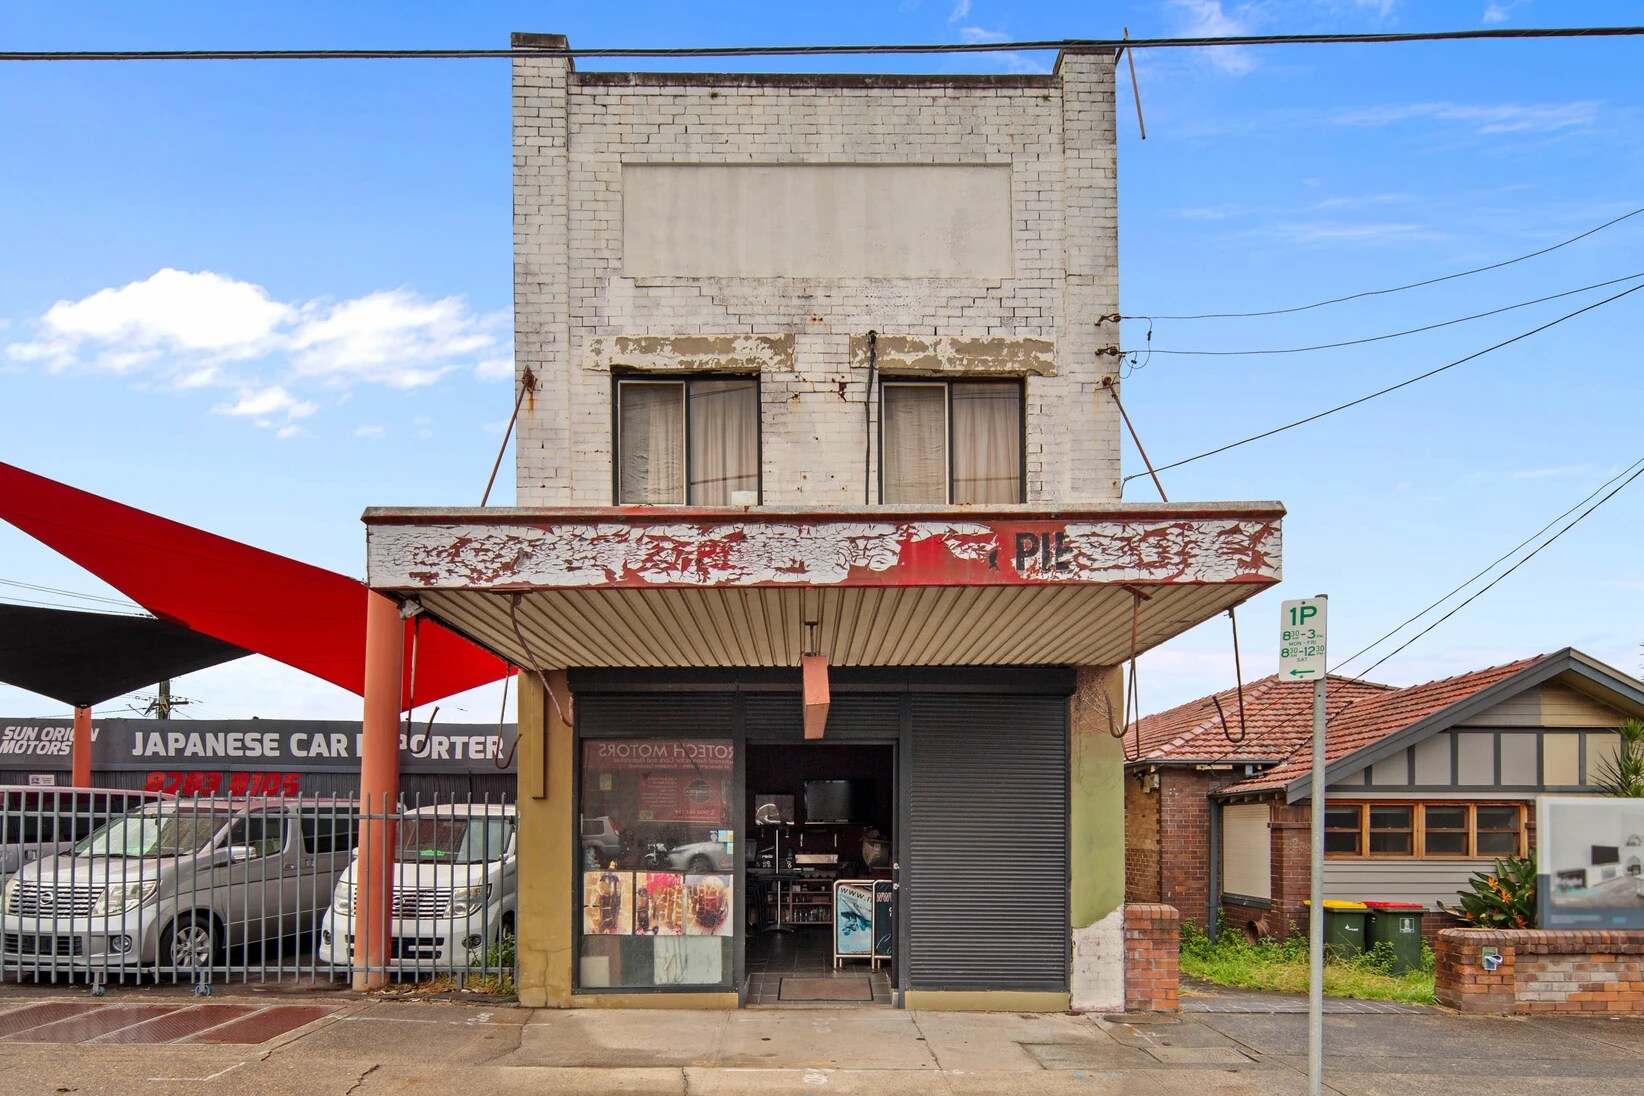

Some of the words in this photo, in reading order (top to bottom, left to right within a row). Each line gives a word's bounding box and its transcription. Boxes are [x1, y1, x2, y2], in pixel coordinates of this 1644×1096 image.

[1290, 606, 1317, 625] 1P
[2, 726, 39, 741] SUN
[41, 727, 100, 742] ORIN
[0, 740, 73, 755] MOTORS
[132, 731, 280, 757] JAPANESE
[290, 732, 348, 758] CAR
[356, 733, 504, 760] ORTER
[144, 771, 223, 797] 8283
[228, 771, 303, 797] 8105
